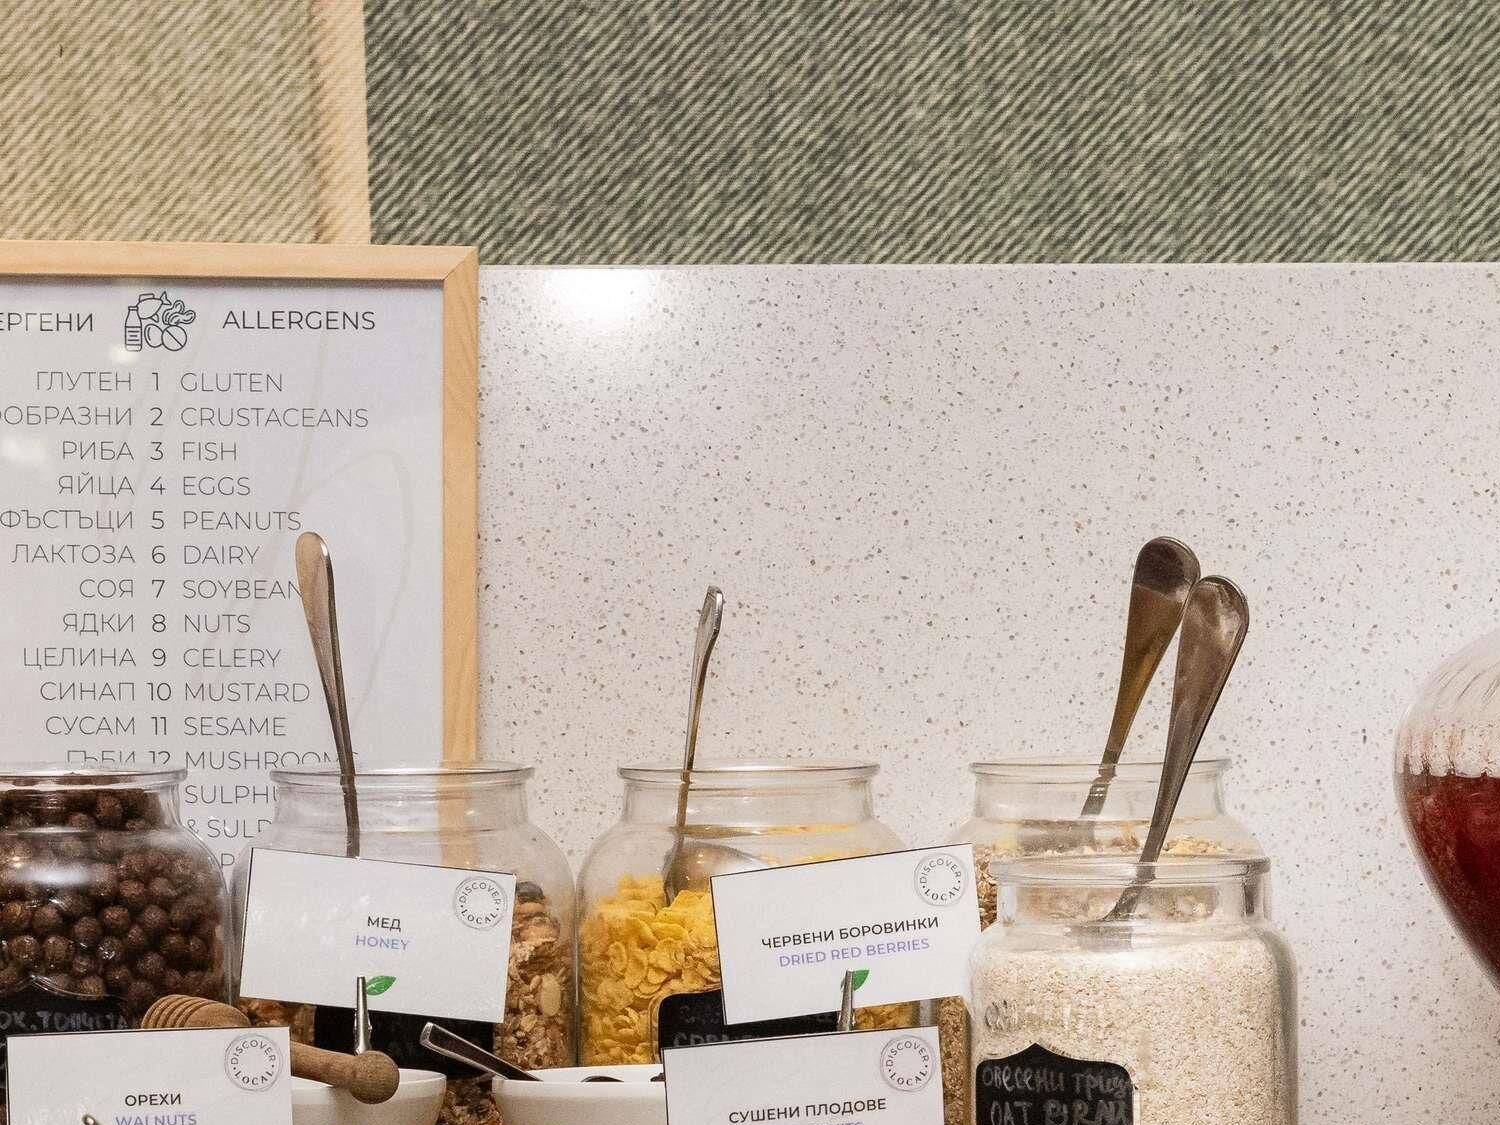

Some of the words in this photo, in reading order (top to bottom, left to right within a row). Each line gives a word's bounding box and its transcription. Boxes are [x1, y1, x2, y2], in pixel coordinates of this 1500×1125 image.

[0, 312, 94, 332] РГЕНИ
[222, 310, 376, 331] ALLERGENS
[36, 371, 132, 392] ГЛУТЕН
[151, 372, 160, 391] 1
[180, 372, 283, 392] GLUTEN
[0, 405, 133, 426] ОБРАЗНИ
[150, 406, 164, 427] 2
[180, 407, 369, 428] CRUSTACEANS
[62, 441, 134, 462] РИБА
[150, 441, 164, 461] 3
[181, 441, 238, 461] FISH
[58, 472, 135, 499] ЯЙЦА
[149, 476, 166, 496] 4
[182, 476, 251, 496] EGGS
[0, 509, 134, 532] ФЪСТЪЦИ
[151, 510, 165, 530] 5
[182, 510, 301, 531] PEANUTS
[11, 543, 135, 564] ЛАКТОЗА
[150, 544, 166, 565] 6
[183, 544, 262, 565] DAIRY
[79, 579, 134, 599] СОЯ
[151, 579, 165, 599] 7
[62, 613, 134, 636] ЯДКИ
[151, 613, 166, 633] 8
[183, 613, 251, 634] NUTS
[23, 647, 136, 670] ЦЕЛИНА
[151, 648, 166, 667] 9
[183, 648, 282, 669] CELERY
[40, 682, 135, 702] СИНАП
[146, 682, 172, 702] 10
[185, 682, 310, 702] MUSTARD
[45, 716, 135, 736] СУСАМ
[151, 716, 167, 736] 11
[183, 716, 287, 737] SESAME
[185, 751, 358, 770] MUSHROO
[918, 857, 963, 885] DISCOVER
[458, 881, 502, 906] DISCOVER
[924, 884, 961, 902] LOCAL
[367, 915, 402, 932] МЕД
[460, 908, 499, 925] LOCAL
[761, 929, 835, 950] ЧЕРВЕНИ
[839, 915, 940, 941] БОРОВИНКИ
[355, 935, 410, 951] HONEY
[778, 952, 827, 968] DRIED
[831, 947, 863, 961] RED
[866, 937, 931, 957] BERRIES
[229, 1038, 277, 1066] DISCOVER
[885, 1040, 930, 1068] DISCOVER
[234, 1070, 275, 1086] LOCAL
[890, 1068, 929, 1086] LOCAL
[124, 1093, 182, 1107] ОРЕХИ
[728, 1105, 801, 1125] СУШЕНИ
[805, 1097, 888, 1118] ПЛОДОВЕ
